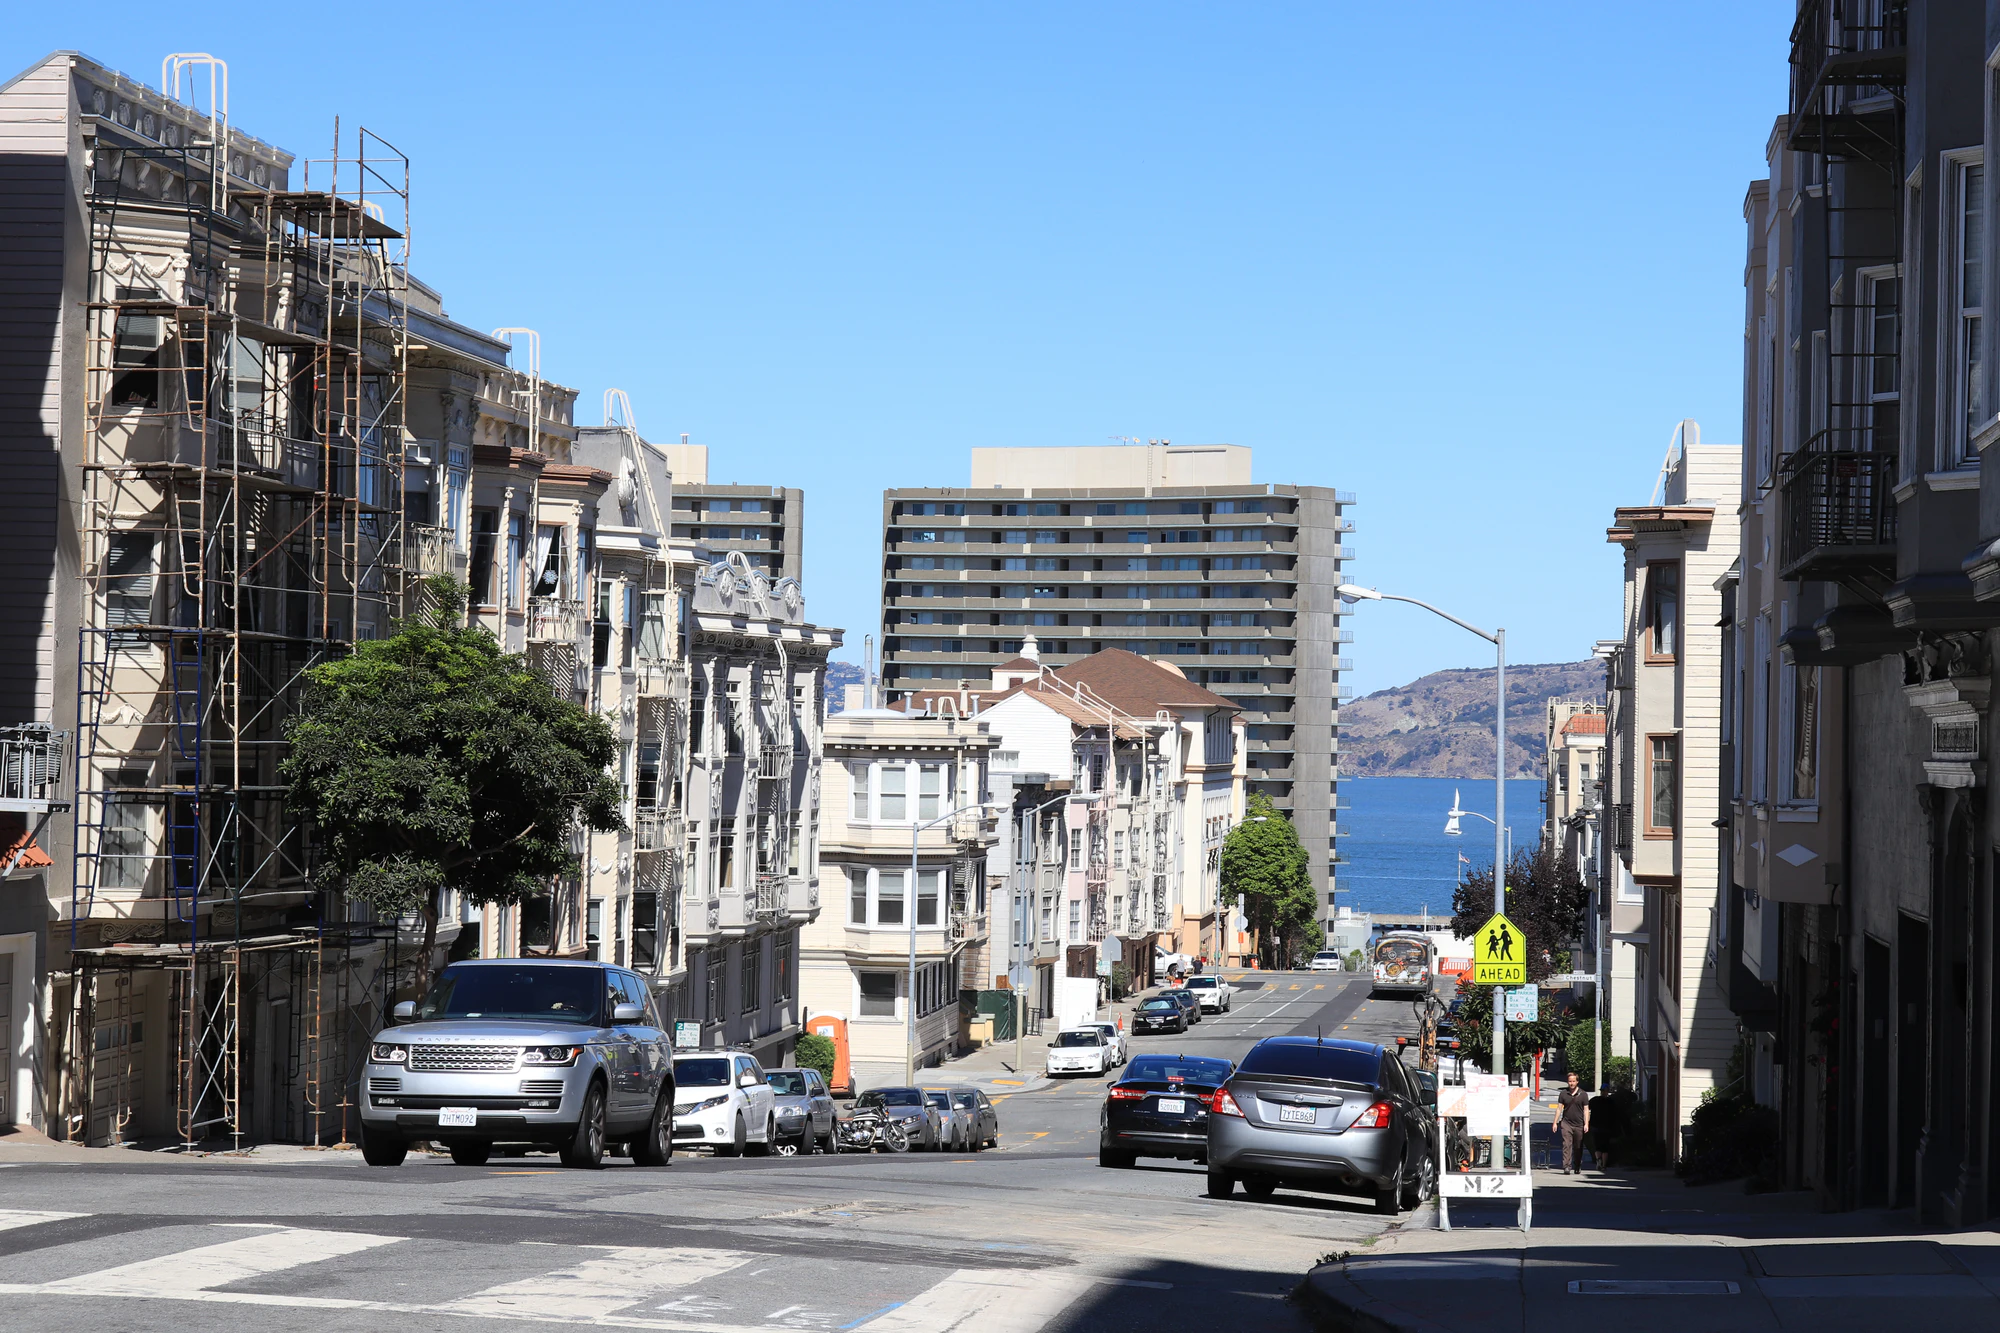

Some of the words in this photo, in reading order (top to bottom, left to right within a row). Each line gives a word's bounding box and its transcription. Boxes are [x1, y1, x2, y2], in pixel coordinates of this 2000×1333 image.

[1480, 968, 1520, 980] AHEAD
[442, 1113, 474, 1124] 7HTM092
[1282, 1109, 1314, 1122] 7YTE868
[1465, 1176, 1481, 1193] M
[1490, 1176, 1504, 1194] 2
